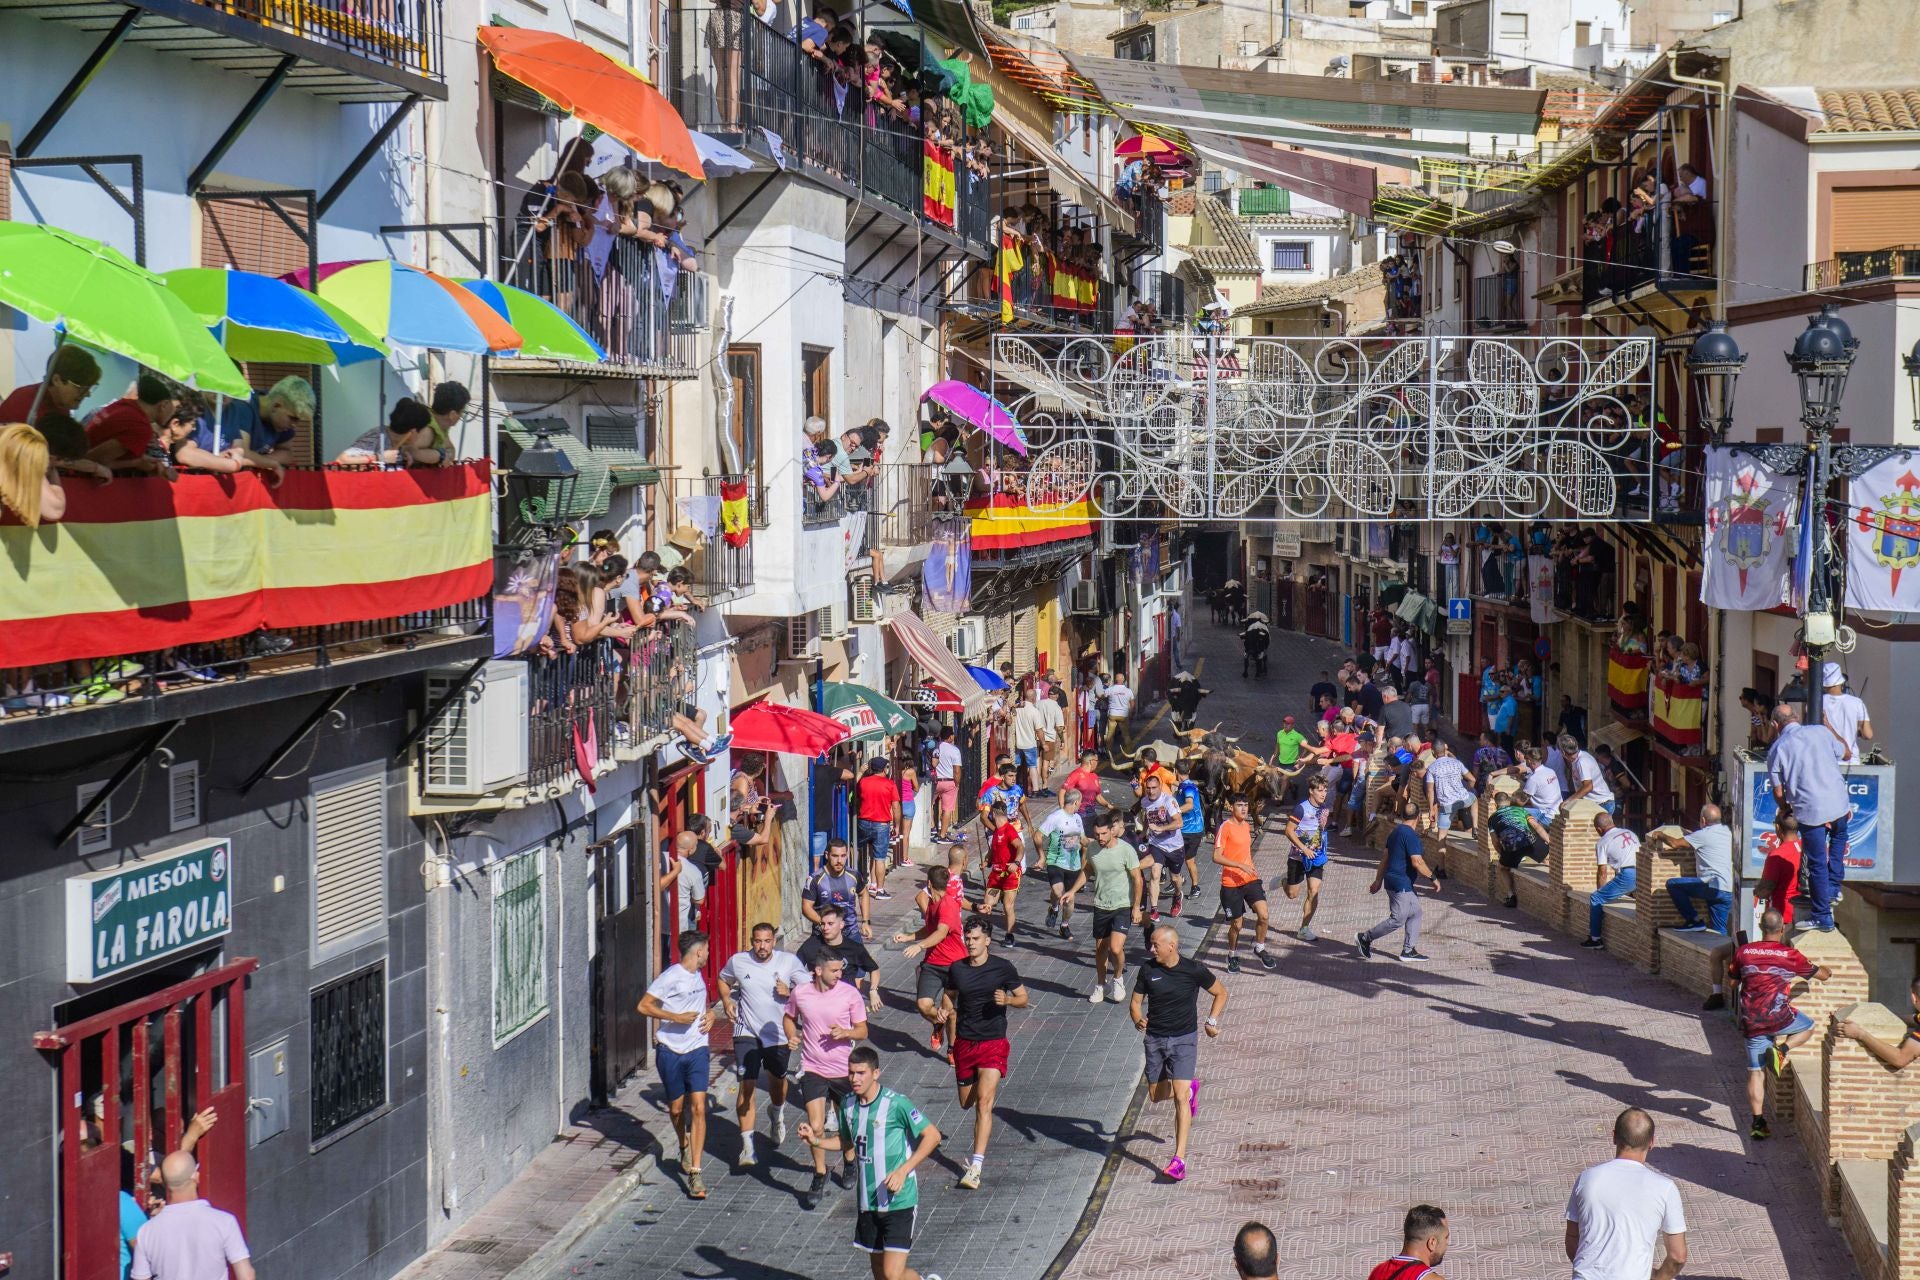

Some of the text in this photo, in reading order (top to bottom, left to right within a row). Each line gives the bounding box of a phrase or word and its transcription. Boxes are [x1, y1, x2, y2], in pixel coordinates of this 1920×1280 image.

[127, 860, 203, 901] MESÓN
[97, 924, 125, 969] LA
[135, 891, 226, 956] FAROLA
